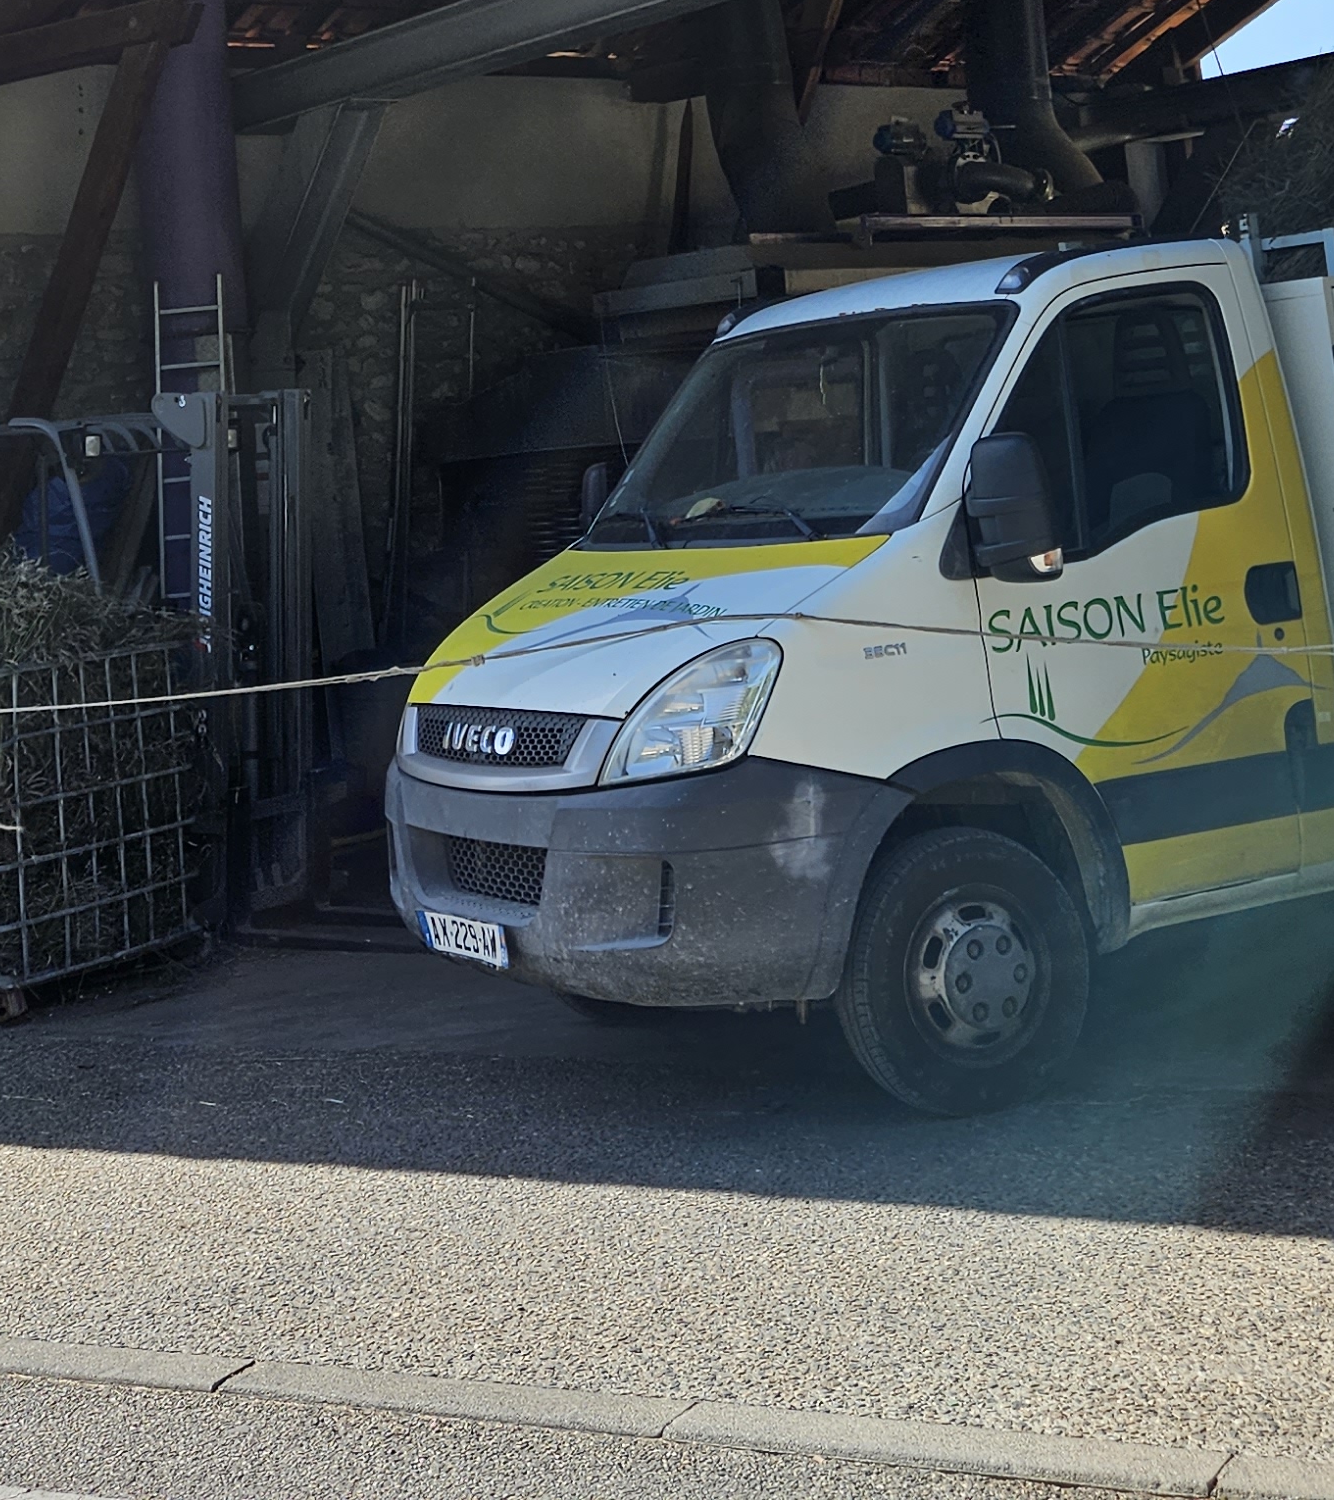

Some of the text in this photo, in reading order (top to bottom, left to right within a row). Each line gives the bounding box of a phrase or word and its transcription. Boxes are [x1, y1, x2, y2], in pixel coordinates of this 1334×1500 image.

[536, 570, 689, 594] SAISON Elie
[519, 598, 576, 611] CREATION
[583, 598, 653, 610] ENTRETIEN
[672, 601, 728, 618] JARDIN
[987, 584, 1226, 654] SAISON Elie
[442, 721, 516, 756] IVECO
